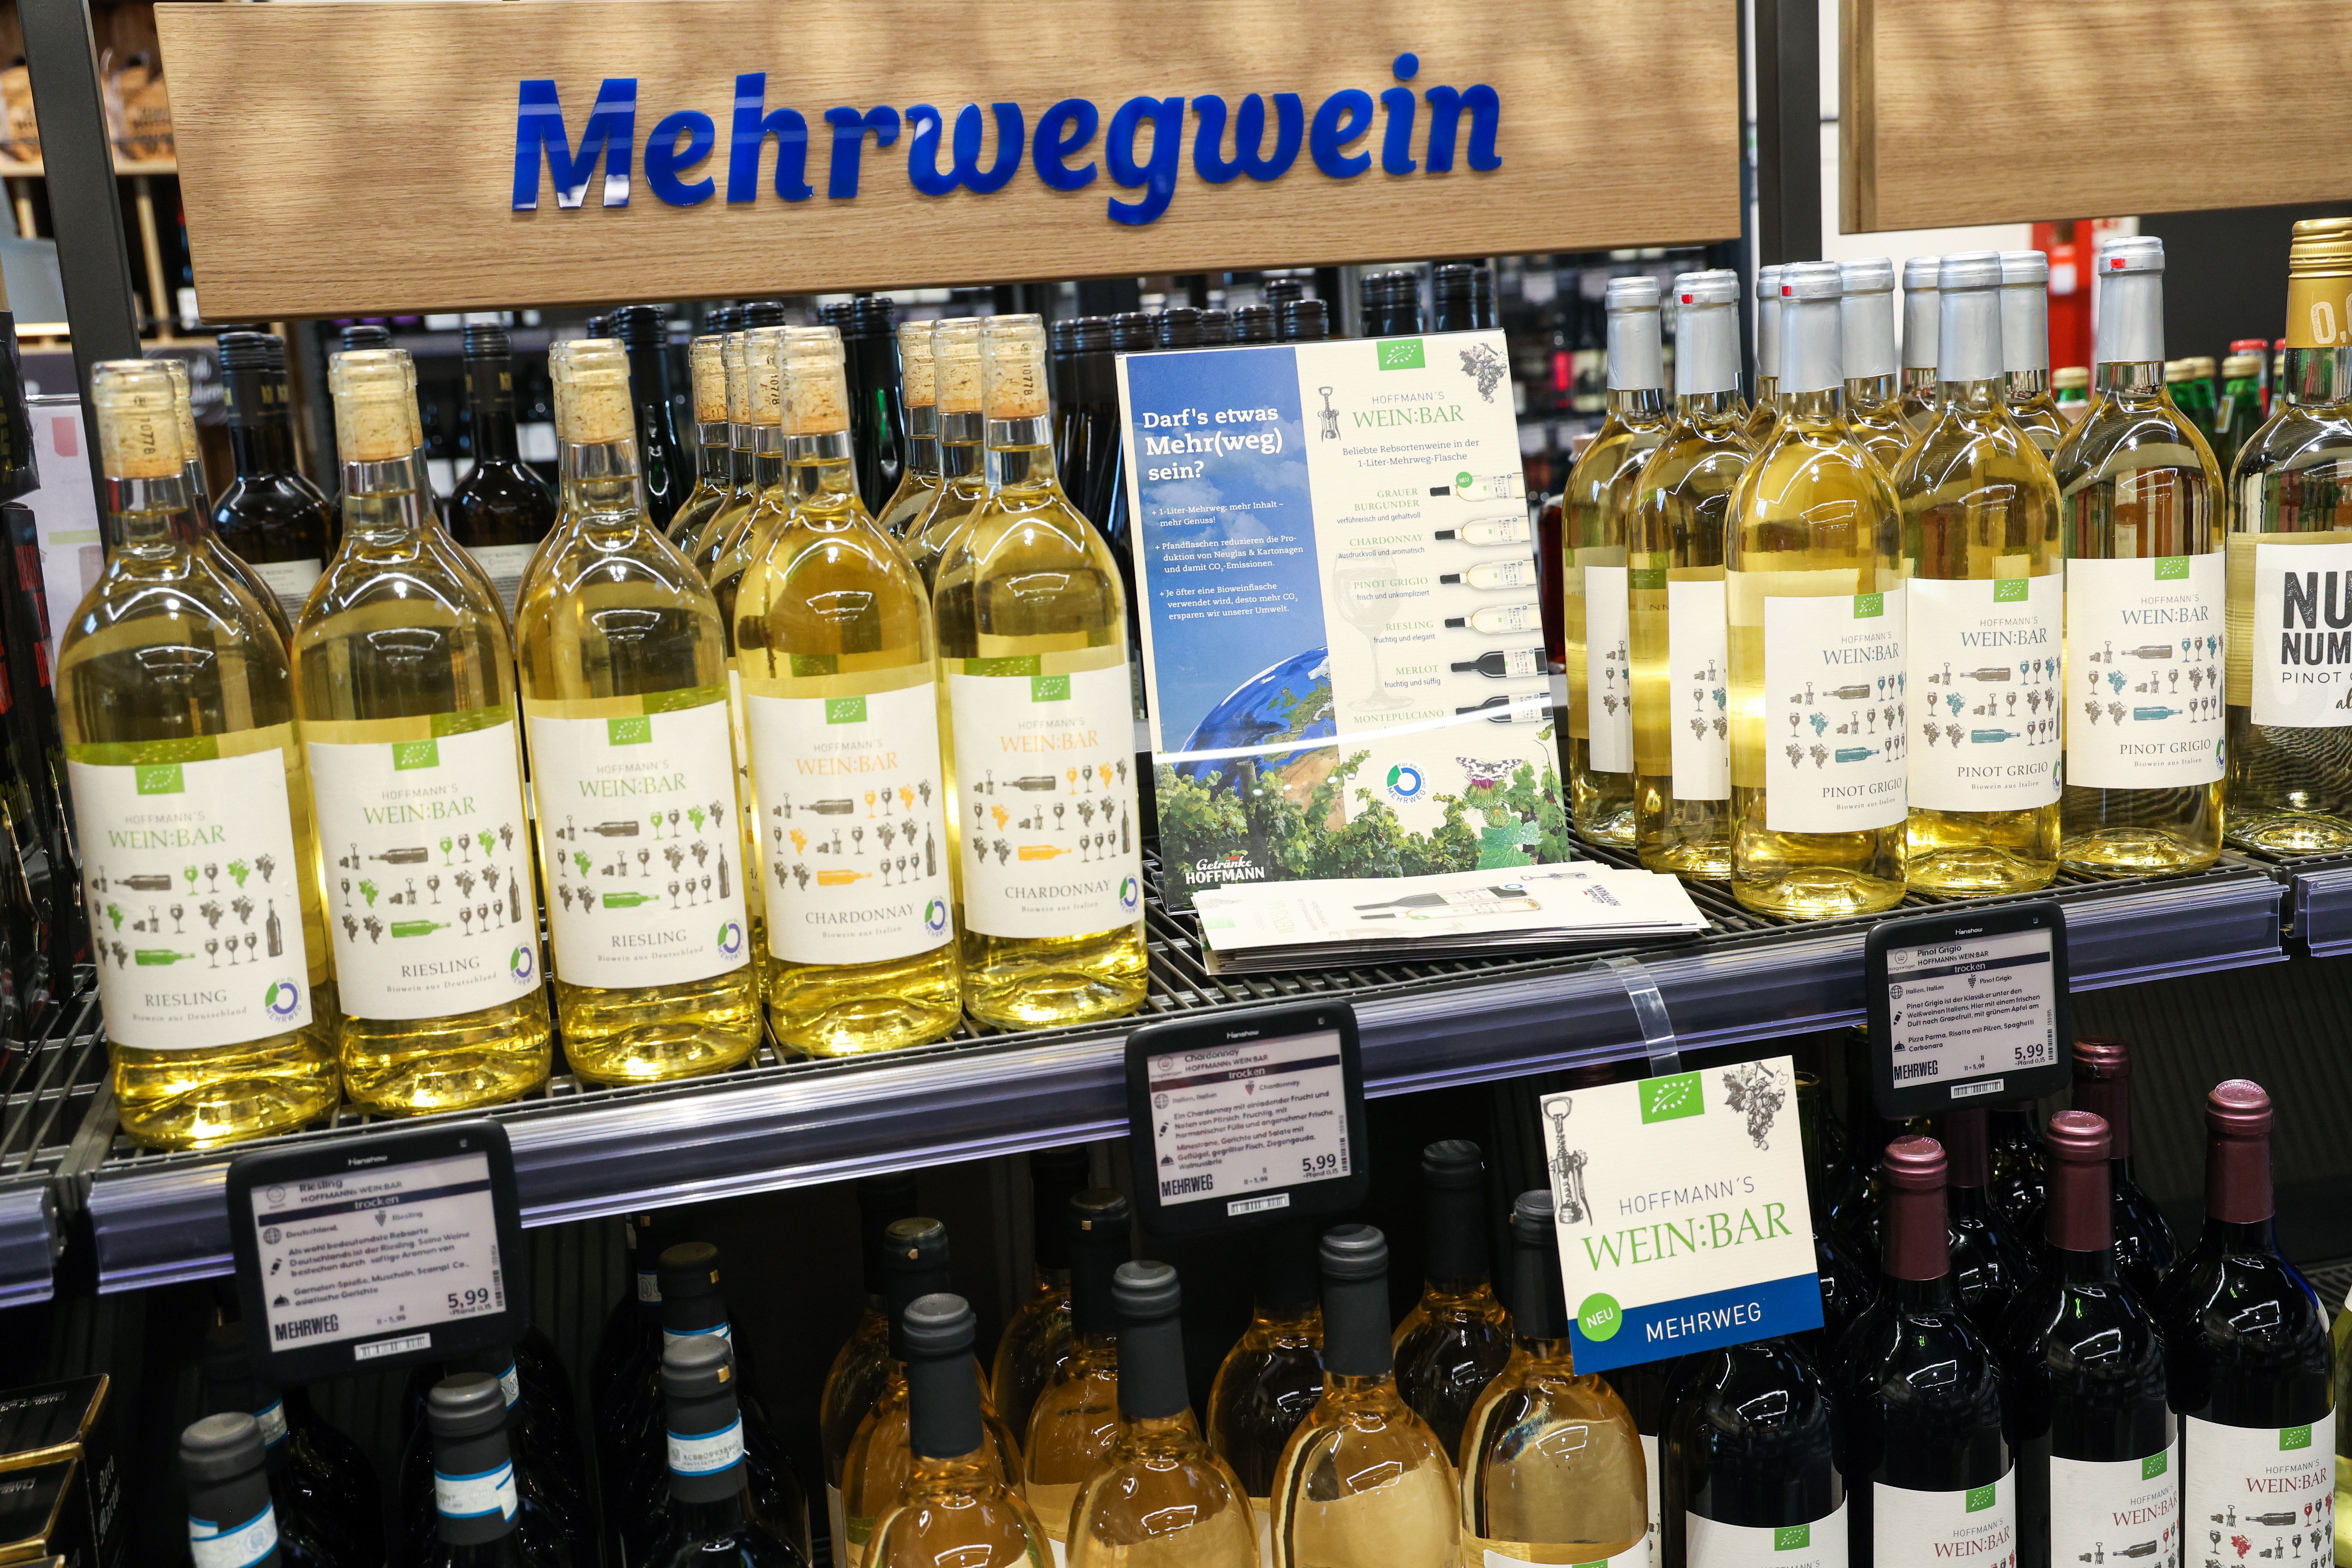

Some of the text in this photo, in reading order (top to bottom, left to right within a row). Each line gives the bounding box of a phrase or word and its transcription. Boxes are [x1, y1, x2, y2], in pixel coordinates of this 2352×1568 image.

[513, 53, 1501, 224] Mehrwegwein
[1022, 364, 1034, 395] 10778
[1143, 408, 1278, 428] Darf's etwas
[1352, 405, 1465, 428] WEIN:BAR
[1145, 427, 1283, 457] Mehr(weg)
[1343, 446, 1377, 456] Beliebte
[1380, 441, 1451, 453] Rebsortenweine
[1358, 452, 1467, 467] 1-Liter-Mehrweg-Flasche
[1148, 460, 1204, 481] sein?
[1377, 488, 1418, 498] GRAUER
[1159, 505, 1227, 515] 1-Liter-Mehrweg:
[1253, 501, 1278, 509] Inhalt
[1354, 500, 1419, 511] BURGUNDER
[1160, 516, 1216, 527] mehr Genuss!
[1337, 515, 1376, 524] verführerisch
[1391, 512, 1421, 522] gehaltvoll
[1162, 540, 1219, 550] Pfandflaschen
[1221, 537, 1265, 546] reduzieren
[1349, 534, 1423, 546] CHARDONNAY
[1163, 553, 1195, 561] duktion
[1214, 548, 1247, 559] Neuglas
[1338, 550, 1376, 559] ausdruckvoll
[1391, 546, 1425, 555] aromatisch
[1164, 565, 1181, 573] und
[1182, 563, 1207, 572] damit
[1166, 590, 1174, 598] Je
[1217, 583, 1277, 593] Bioweinflasche
[1354, 577, 1428, 589] PINOT GRIGIO
[1167, 599, 1211, 608] verwendet
[1259, 593, 1281, 602] mehr
[1388, 590, 1430, 599] unkompliziert
[1169, 612, 1205, 621] ersparen
[1254, 605, 1289, 613] Umwelt.
[2121, 606, 2209, 625] WEIN:BAR
[1386, 621, 1434, 631] RIESLING
[1412, 633, 1436, 642] elegant
[1960, 628, 2047, 646] WEIN:BAR
[1822, 642, 1899, 665] WEIN:BAR
[1396, 665, 1439, 675] MERLOT
[2283, 672, 2341, 683] PINOT
[1384, 680, 1408, 688] fruchtig
[1423, 677, 1441, 686] süffig
[1354, 710, 1444, 724] MONTEPULCIANO
[1000, 730, 1098, 753] WEIN:BAR
[2120, 739, 2210, 754] PINOT GRIGIO
[796, 751, 898, 776] WEIN:BAR
[1957, 762, 2048, 777] PINOT GRIGIO
[579, 773, 686, 797] WEIN:BAR
[1823, 777, 1902, 798] PINOT GRIGIO
[1387, 787, 1426, 804] MEHRWEG
[363, 796, 475, 824] WEIN:BAR
[107, 825, 226, 849] WEIN:BAR
[1196, 855, 1252, 871] Getränke
[1185, 866, 1265, 884] HOFFMANN
[1005, 880, 1109, 898] CHARDONNAY
[806, 904, 912, 924] CHARDONNAY
[612, 930, 686, 947] RIESLING
[1917, 945, 1962, 957] Pinot Grigio
[1918, 951, 1989, 966] HOFFMANNs WEIN:BAR
[401, 956, 479, 977] RIESLING
[1955, 963, 1985, 973] trocken
[145, 989, 227, 1007] RIESLING
[1964, 993, 1992, 1001] Klassiker
[1907, 1009, 1945, 1018] Weißweinen
[1940, 1013, 1973, 1022] Grapefruit,
[1986, 1008, 2010, 1017] grünem
[2004, 1019, 2034, 1029] Spaghetti
[1185, 1048, 1240, 1062] Chardonnay
[1909, 1043, 1943, 1052] Carbonara
[2015, 1044, 2043, 1061] 5,99
[1894, 1060, 1938, 1081] MEHRWEG
[1303, 1154, 1336, 1172] 5,99
[299, 1179, 343, 1192] Riesling
[1161, 1174, 1213, 1197] MEHRWEG
[1581, 1202, 1792, 1271] WEIN:BAR
[448, 1288, 488, 1308] 5,99
[1586, 1307, 1613, 1328] NEU
[1646, 1302, 1761, 1343] MEHRWEG
[274, 1314, 339, 1341] MEHRWEG
[2245, 1468, 2327, 1493] WEIN:BAR
[2112, 1490, 2178, 1526] WEIN:BAR
[1933, 1525, 2010, 1557] WEIN:BAR
